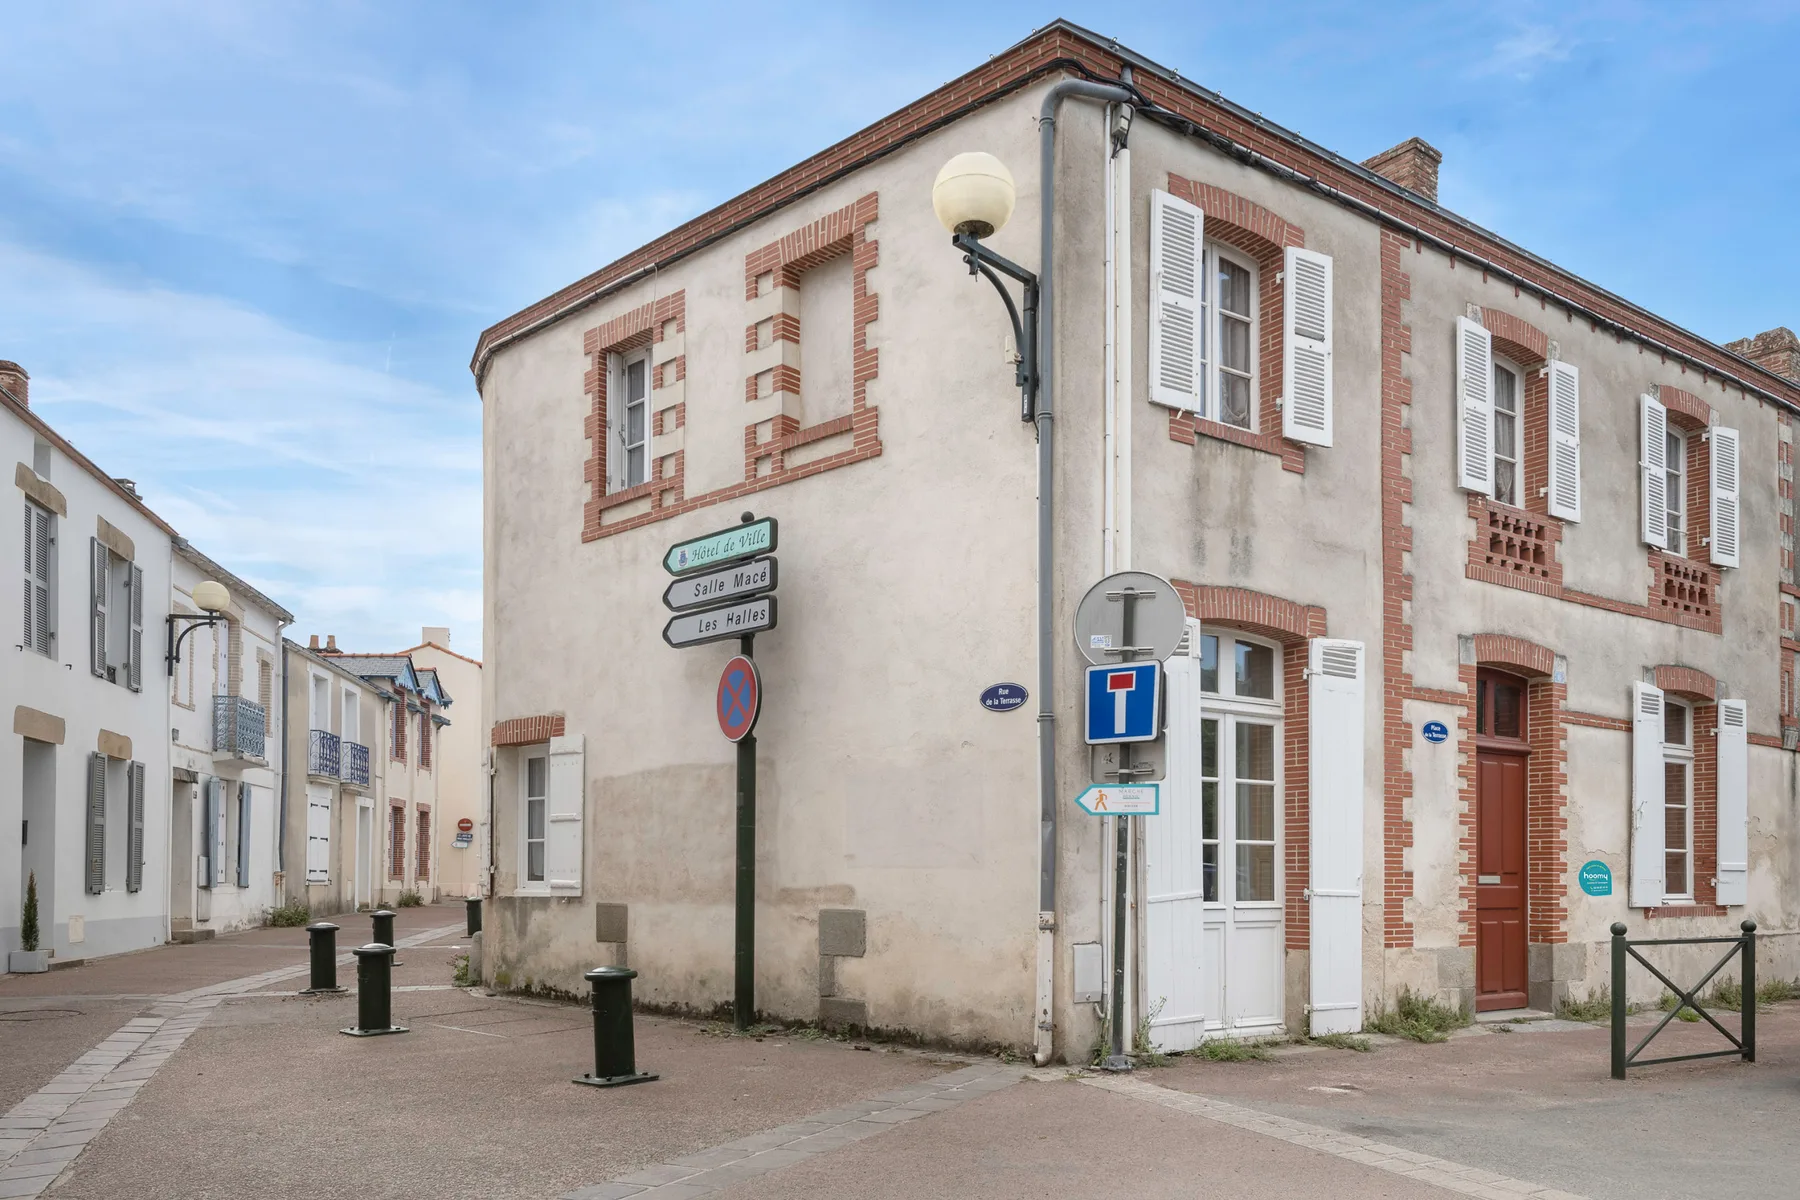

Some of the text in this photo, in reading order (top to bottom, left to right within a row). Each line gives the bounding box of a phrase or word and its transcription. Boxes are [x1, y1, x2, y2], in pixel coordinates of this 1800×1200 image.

[691, 529, 765, 561] Hôtel de Ville
[694, 566, 767, 597] Salle Macé
[698, 608, 766, 633] Les Halles
[998, 687, 1009, 695] Rue
[985, 697, 1022, 706] de la Terrasse
[1583, 872, 1608, 880] hoomy
